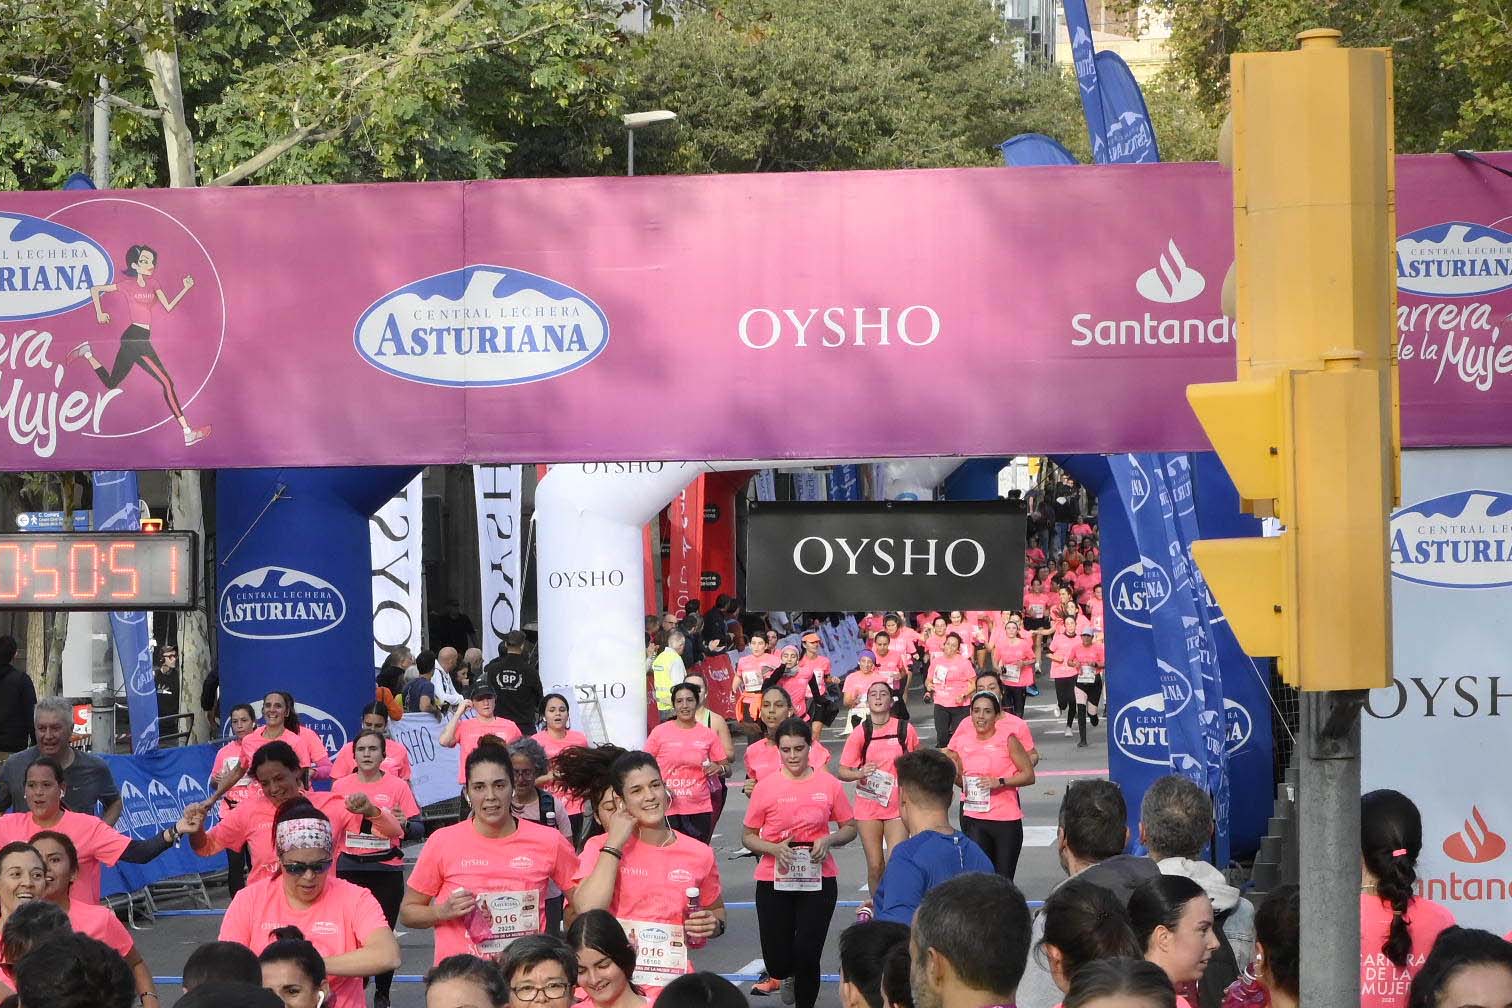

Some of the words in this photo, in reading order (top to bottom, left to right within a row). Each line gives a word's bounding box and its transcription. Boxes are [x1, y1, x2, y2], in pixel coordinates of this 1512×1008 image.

[16, 247, 89, 259] LECHERA
[1411, 248, 1462, 256] CENTRAL
[1467, 247, 1512, 255] LECHER
[1397, 253, 1512, 278] ASTURIAN
[414, 307, 491, 321] CENTRAL
[499, 305, 581, 319] LECHERA
[1397, 302, 1492, 332] arrera
[373, 312, 590, 357] ASTURIANA
[737, 305, 941, 349] OYSHO
[1071, 312, 1237, 347] Santand
[1420, 332, 1439, 361] la
[1433, 326, 1512, 391] Muje
[1417, 524, 1484, 535] CENTRAL
[791, 536, 986, 579] OYSHO
[549, 569, 625, 590] OYSHO
[236, 591, 279, 599] CENTRAL
[283, 591, 332, 599] LECHERA
[223, 595, 337, 624] ASTURIANA
[501, 673, 517, 684] BP
[552, 682, 627, 701] SHO
[305, 722, 333, 731] HERA
[397, 726, 436, 767] SHO
[1416, 872, 1512, 901] ntan
[495, 914, 518, 924] 016
[641, 946, 665, 958] 016
[1360, 953, 1427, 968] ARRA
[1365, 967, 1386, 981] DE
[1392, 967, 1413, 980] LA
